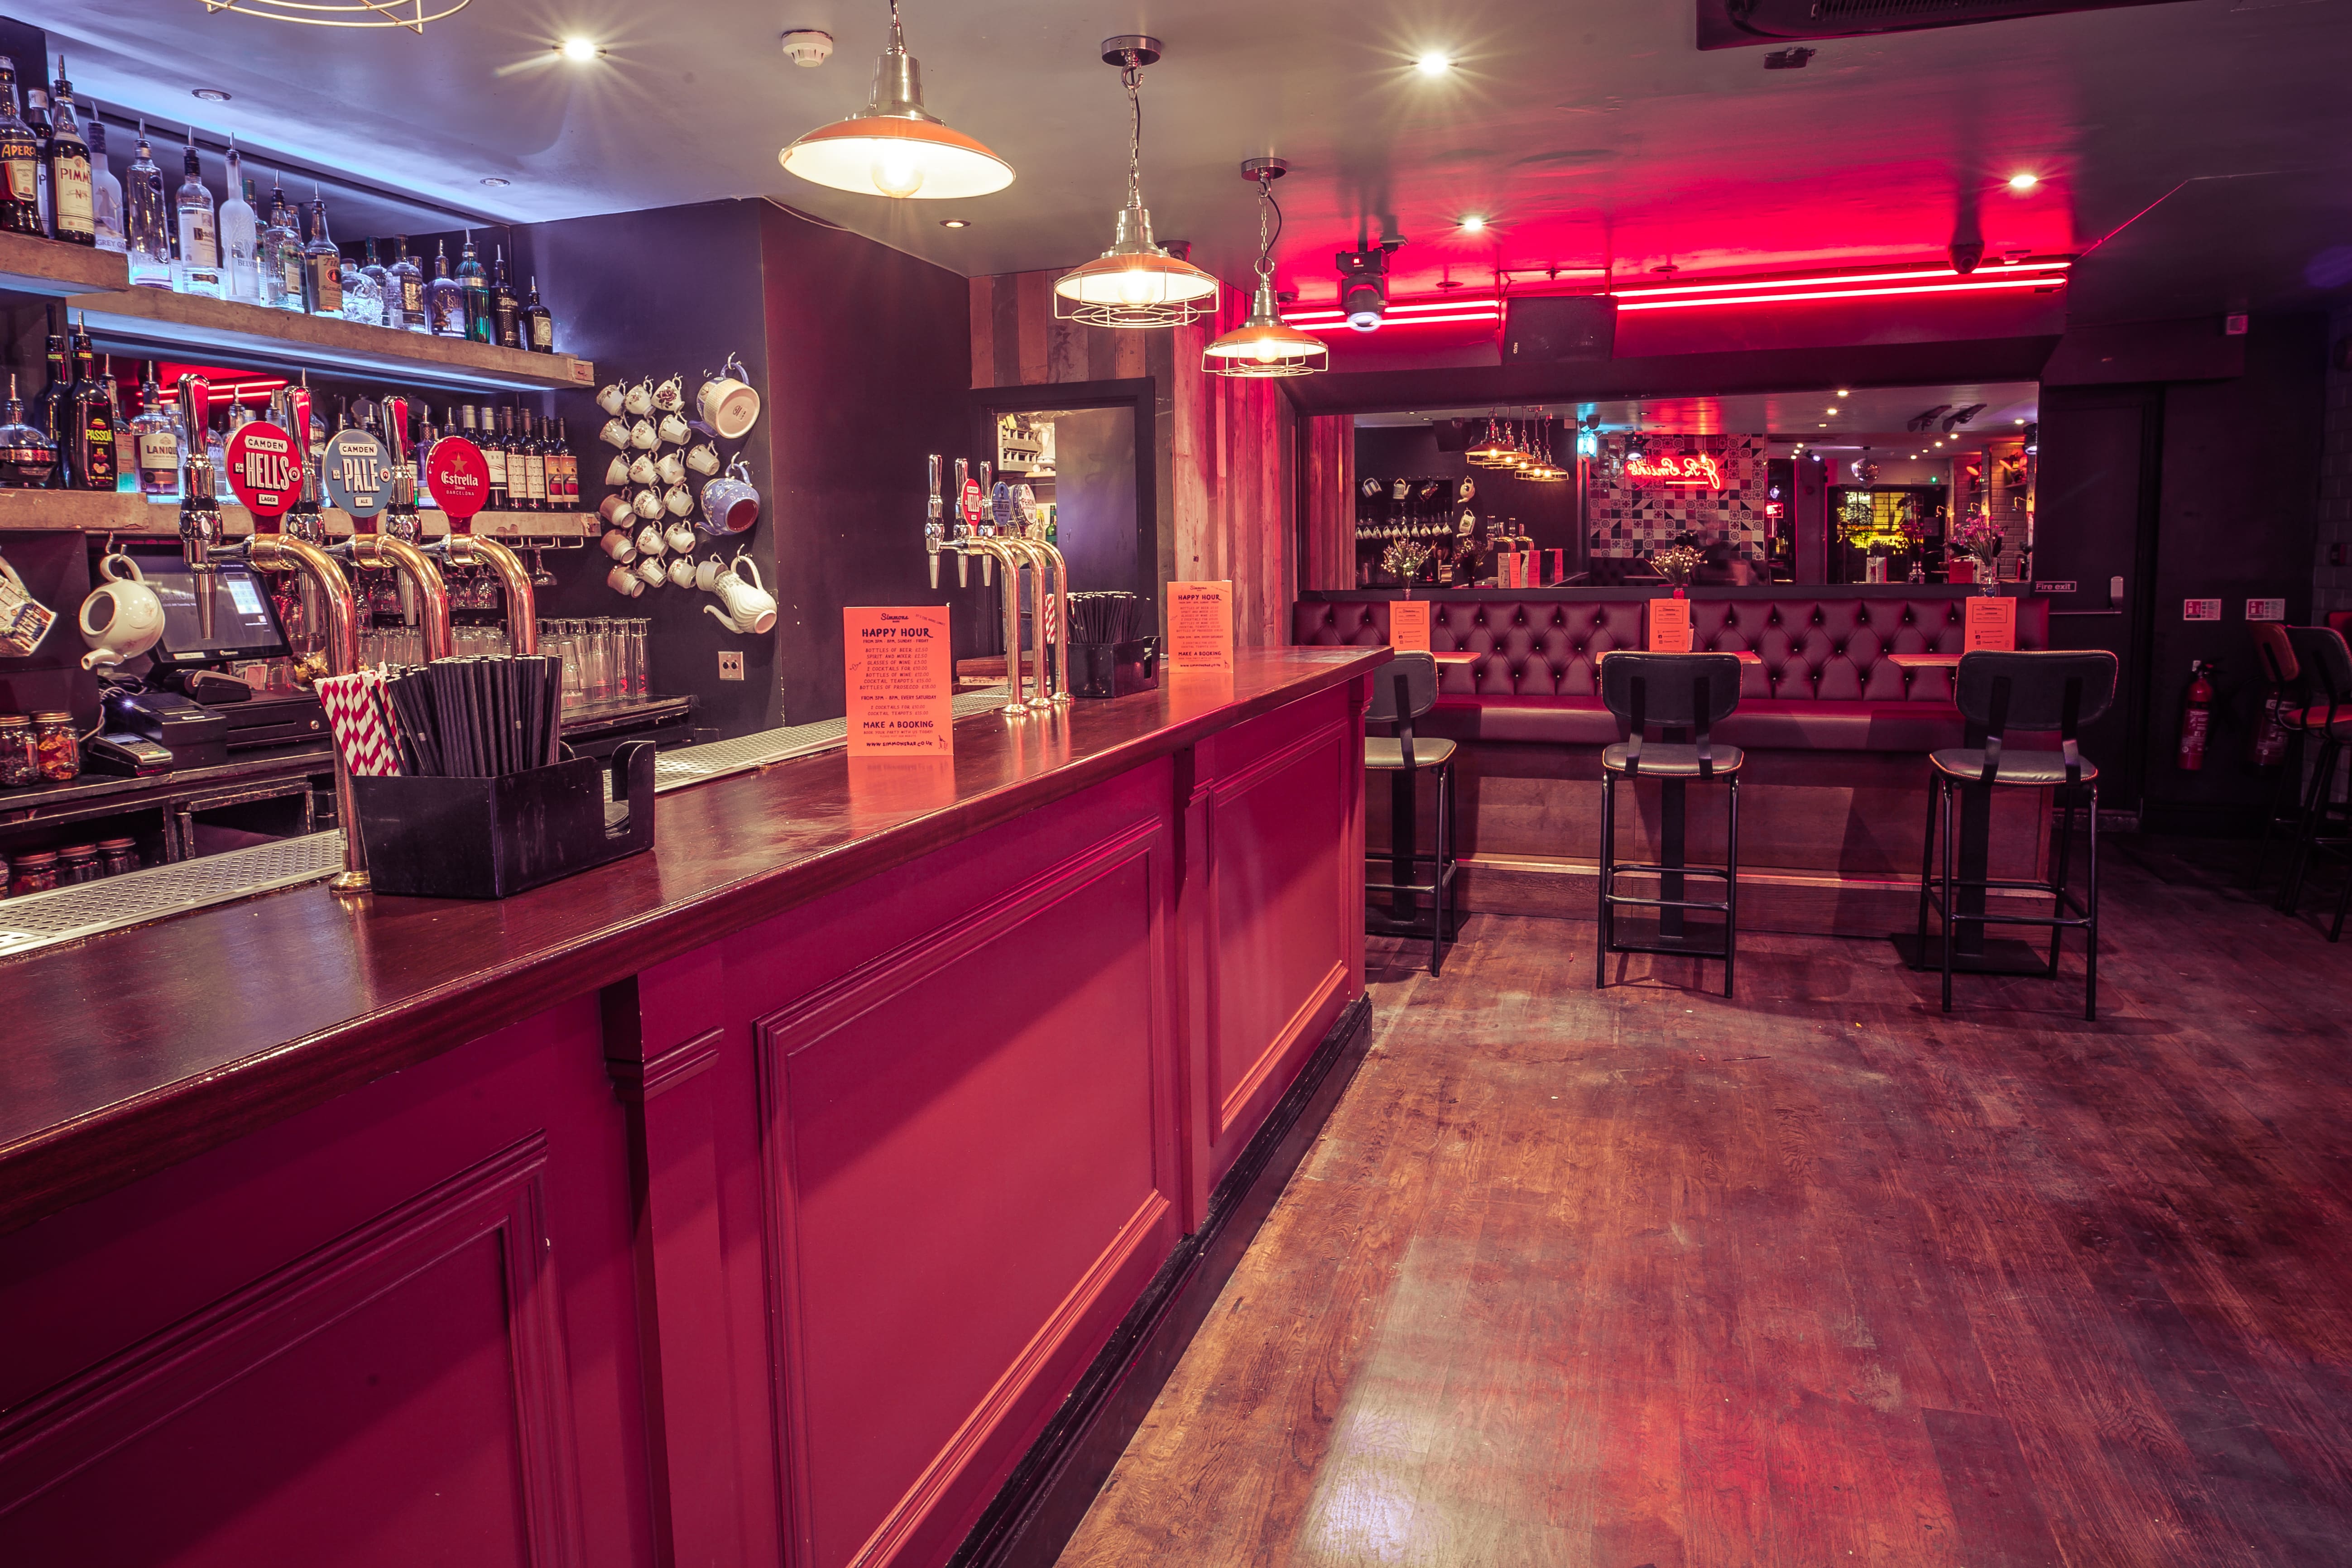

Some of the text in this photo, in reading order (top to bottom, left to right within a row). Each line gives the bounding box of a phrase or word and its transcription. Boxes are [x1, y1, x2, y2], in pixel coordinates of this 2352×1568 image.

[248, 438, 283, 450] CAMDEN
[246, 451, 290, 491] HELLS
[342, 458, 380, 492] PALE
[441, 470, 478, 486] Estrella
[881, 613, 909, 621] Simmons
[862, 628, 933, 638] HAPPY HOUR
